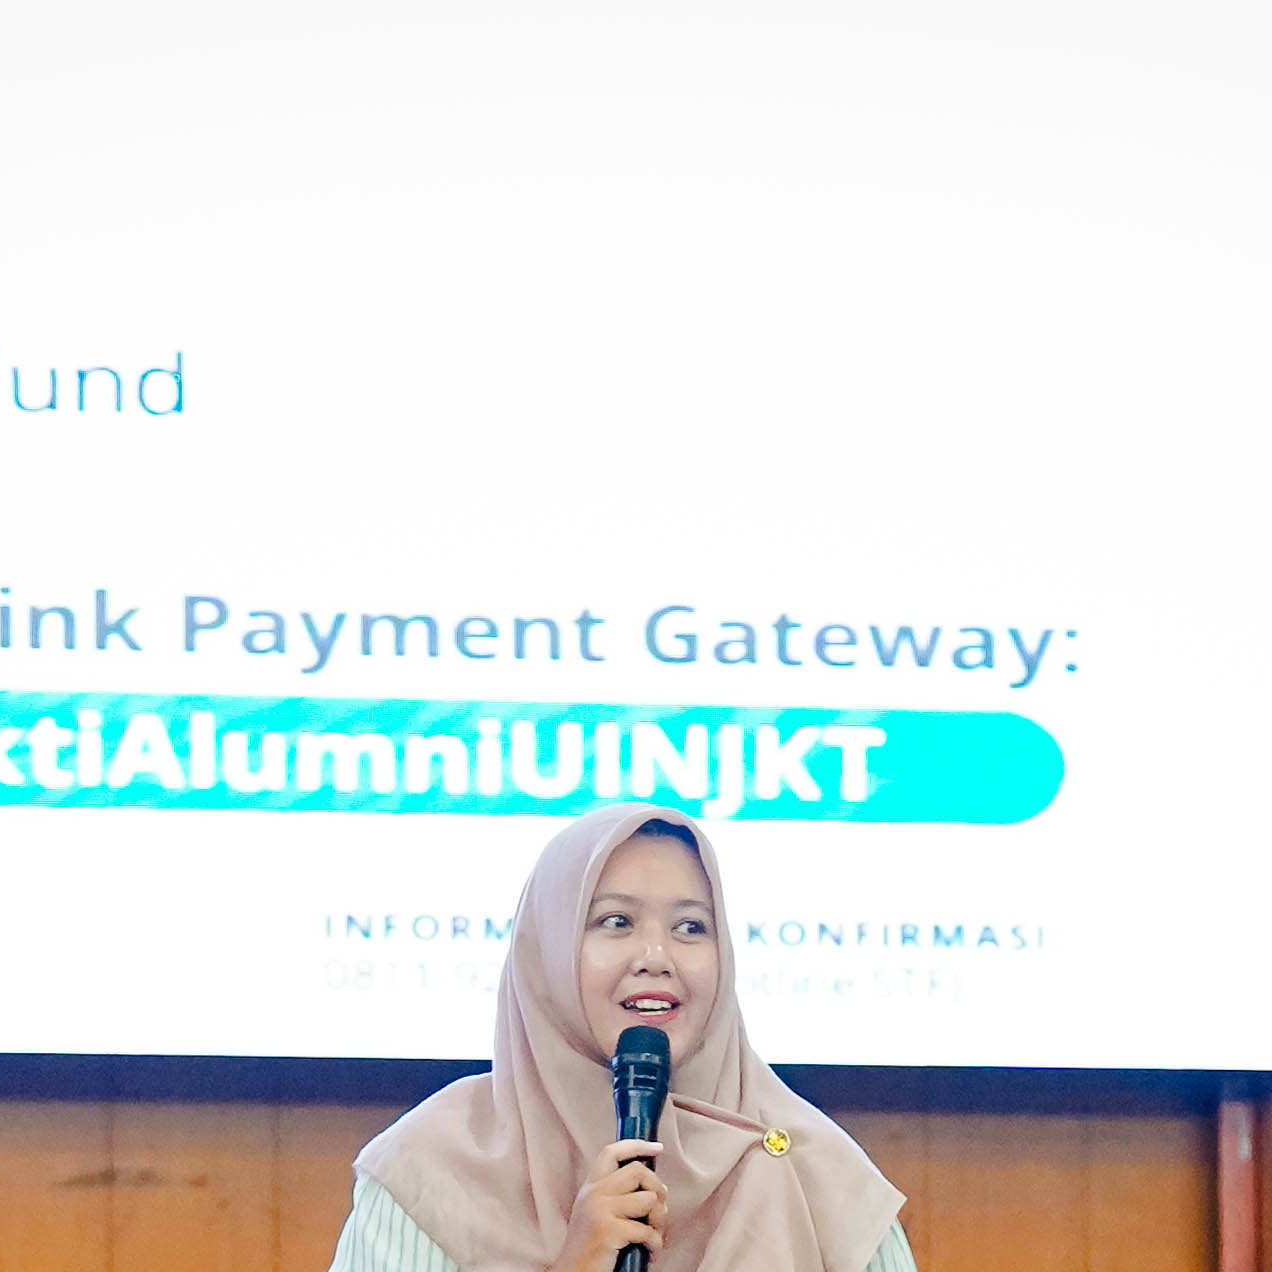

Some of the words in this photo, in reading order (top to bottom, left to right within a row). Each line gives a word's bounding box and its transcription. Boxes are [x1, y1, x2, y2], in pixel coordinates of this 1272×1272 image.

[183, 594, 607, 676] Payment
[643, 604, 1081, 691] Gateway:
[326, 912, 514, 943] INFORM
